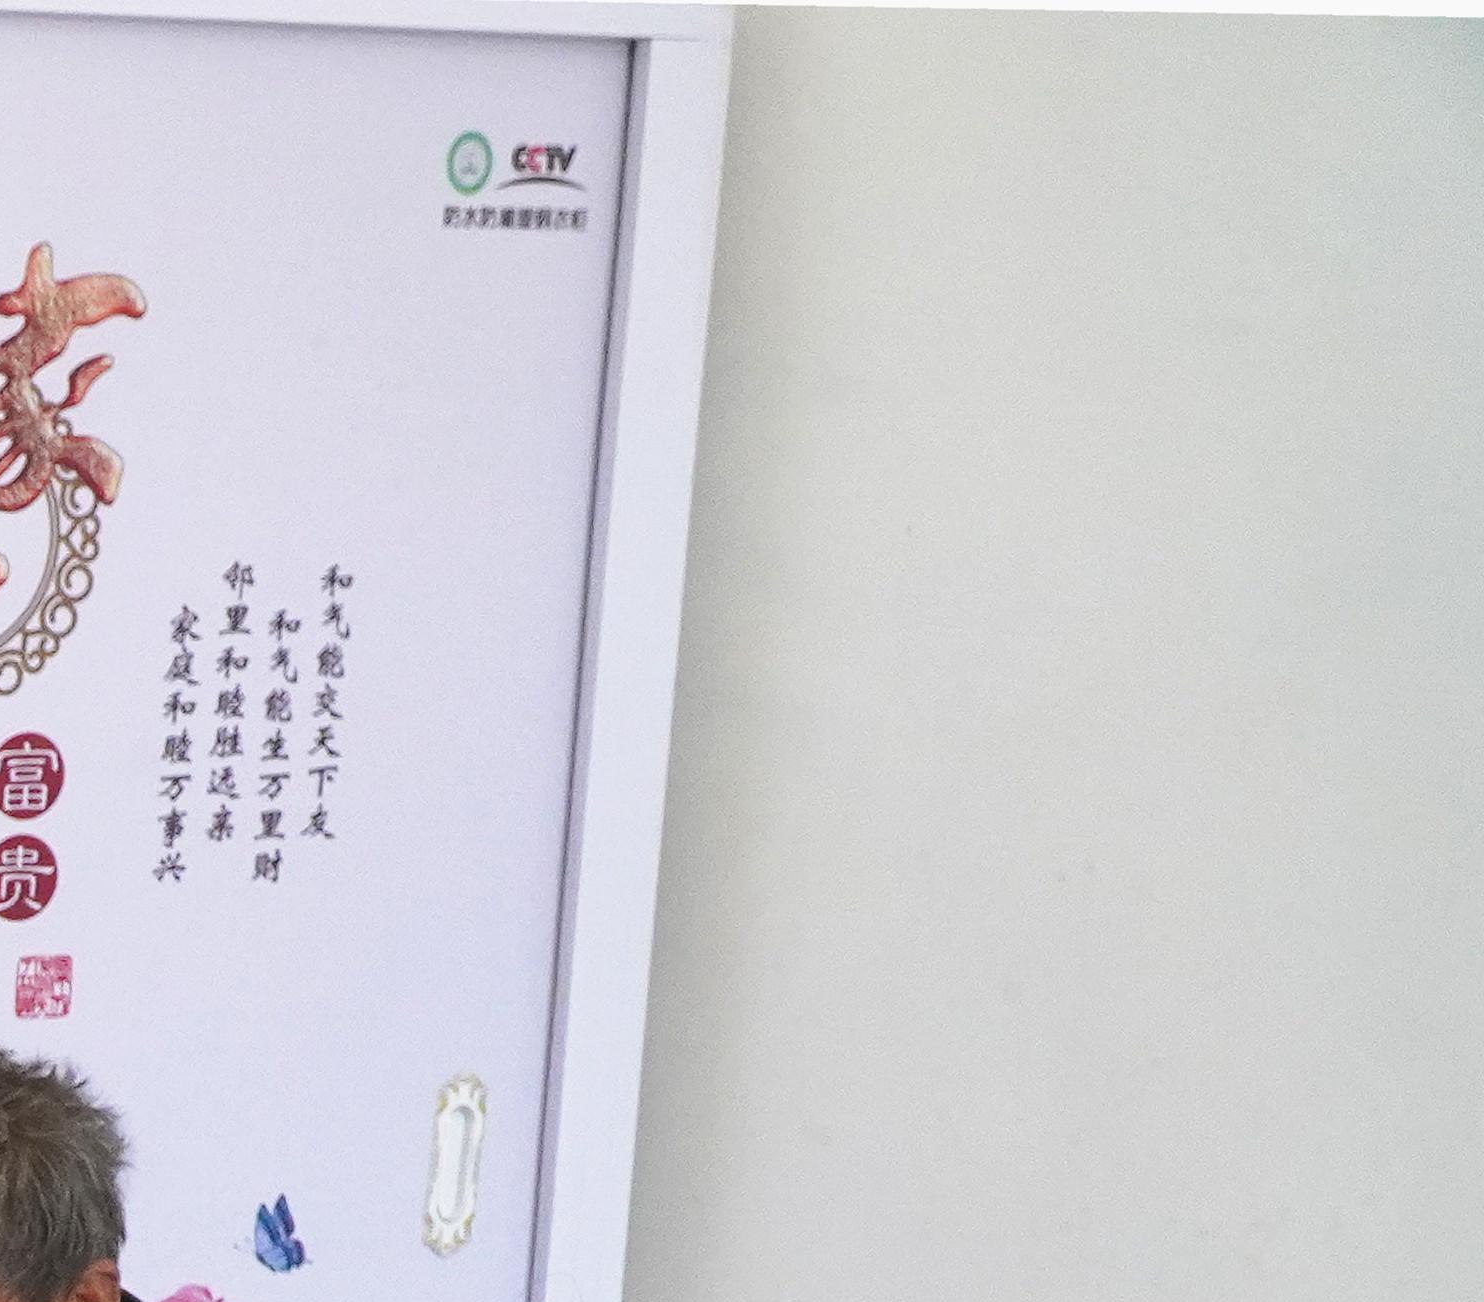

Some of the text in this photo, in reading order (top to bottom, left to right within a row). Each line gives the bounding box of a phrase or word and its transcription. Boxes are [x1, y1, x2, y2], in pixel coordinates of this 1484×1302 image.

[511, 142, 577, 173] CCTV
[152, 604, 202, 883] 家庭和睦万事兴
[205, 560, 255, 843] 邻里和睦胜远亲
[252, 608, 302, 883] 和气能生万里财
[299, 563, 354, 840] 和气能交天下友
